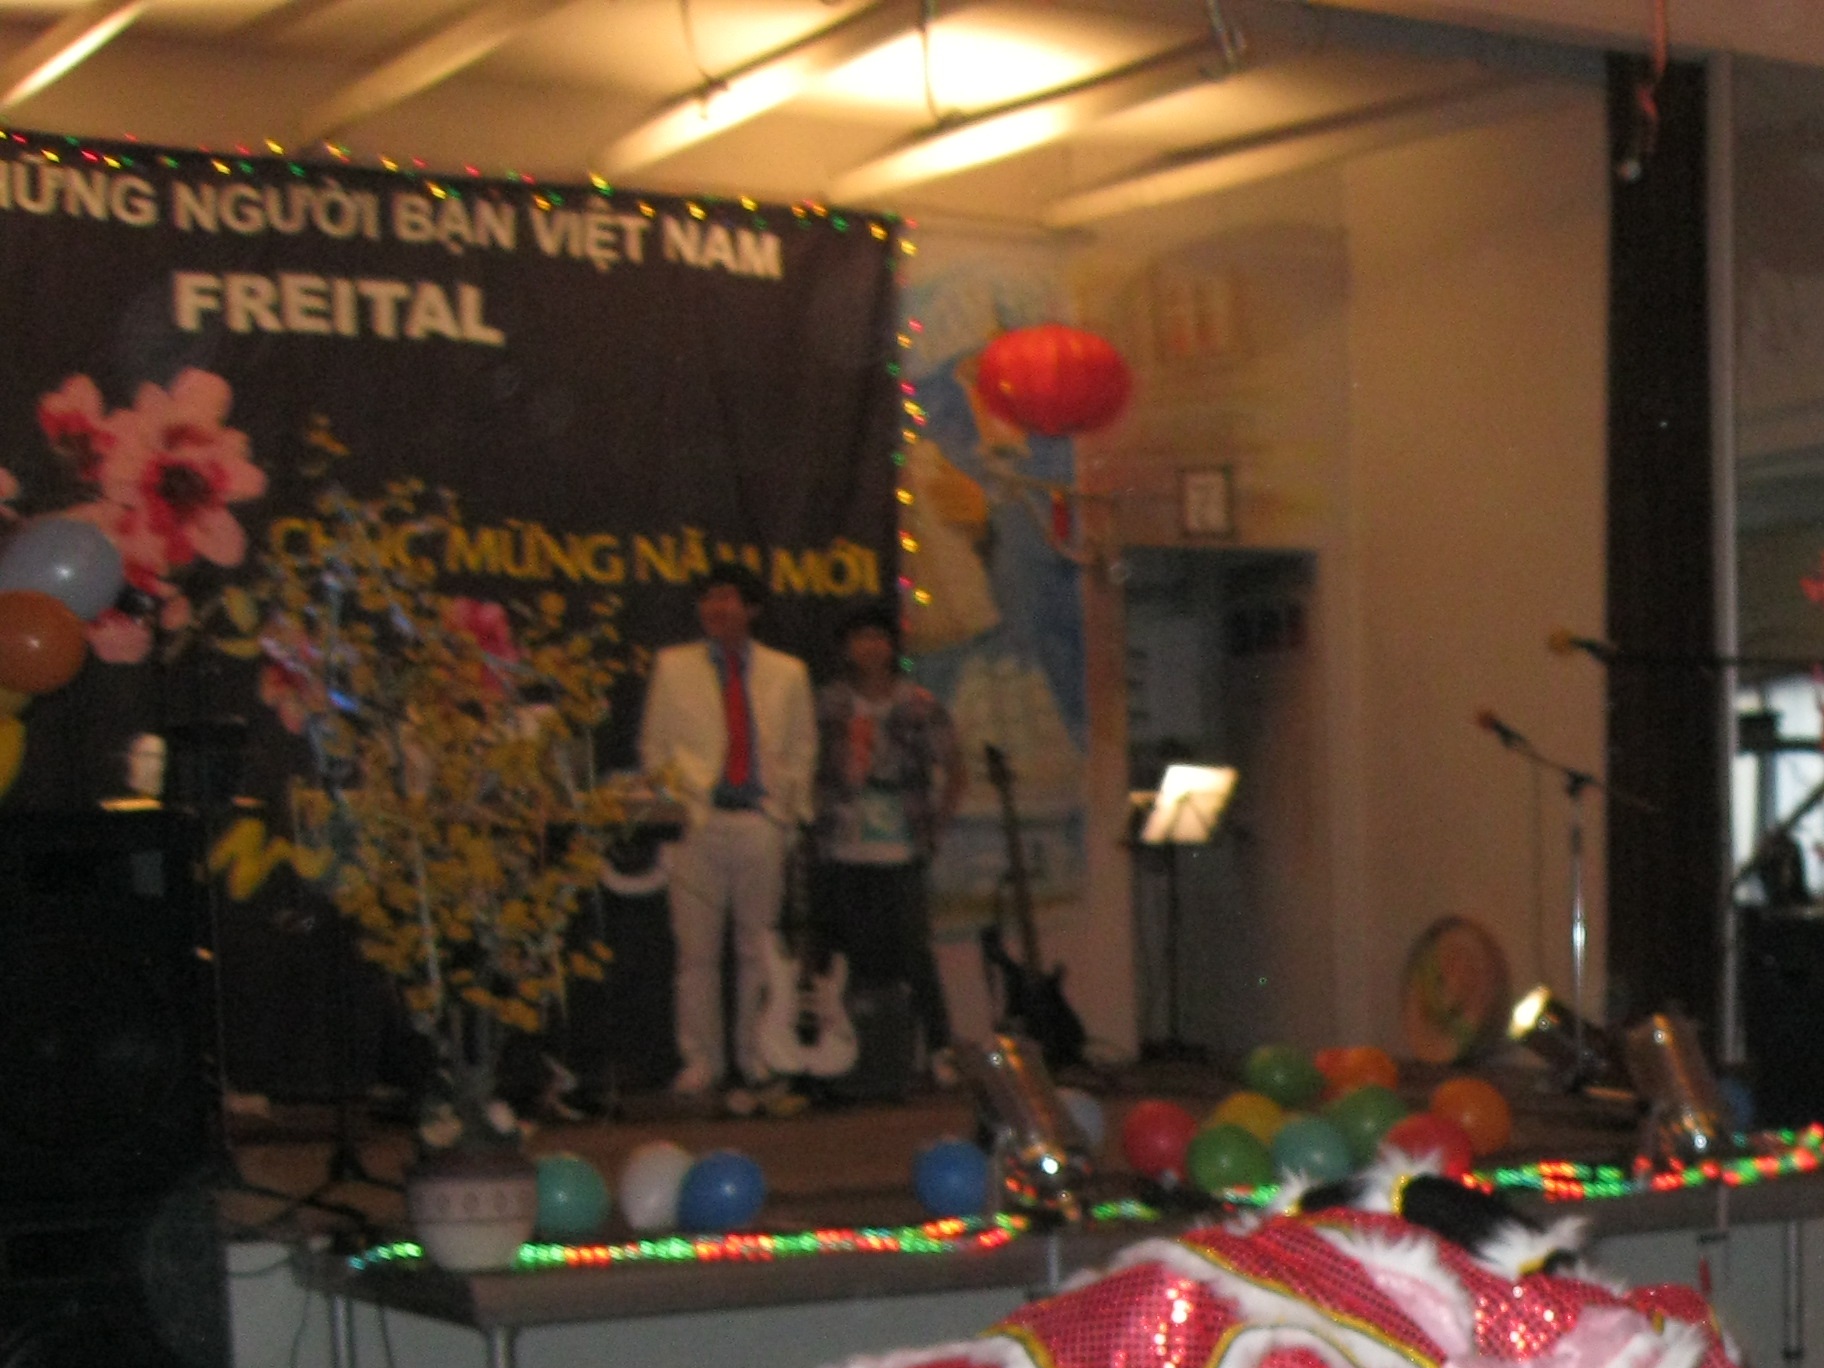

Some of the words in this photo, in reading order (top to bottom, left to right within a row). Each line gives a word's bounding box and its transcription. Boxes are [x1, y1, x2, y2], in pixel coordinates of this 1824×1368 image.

[171, 174, 382, 242] NGƯỜI
[392, 192, 517, 255] BẠN
[529, 194, 651, 274] VIỆT
[661, 214, 784, 281] NAM
[172, 270, 507, 347] FREITAL
[446, 517, 626, 584] MỪNG
